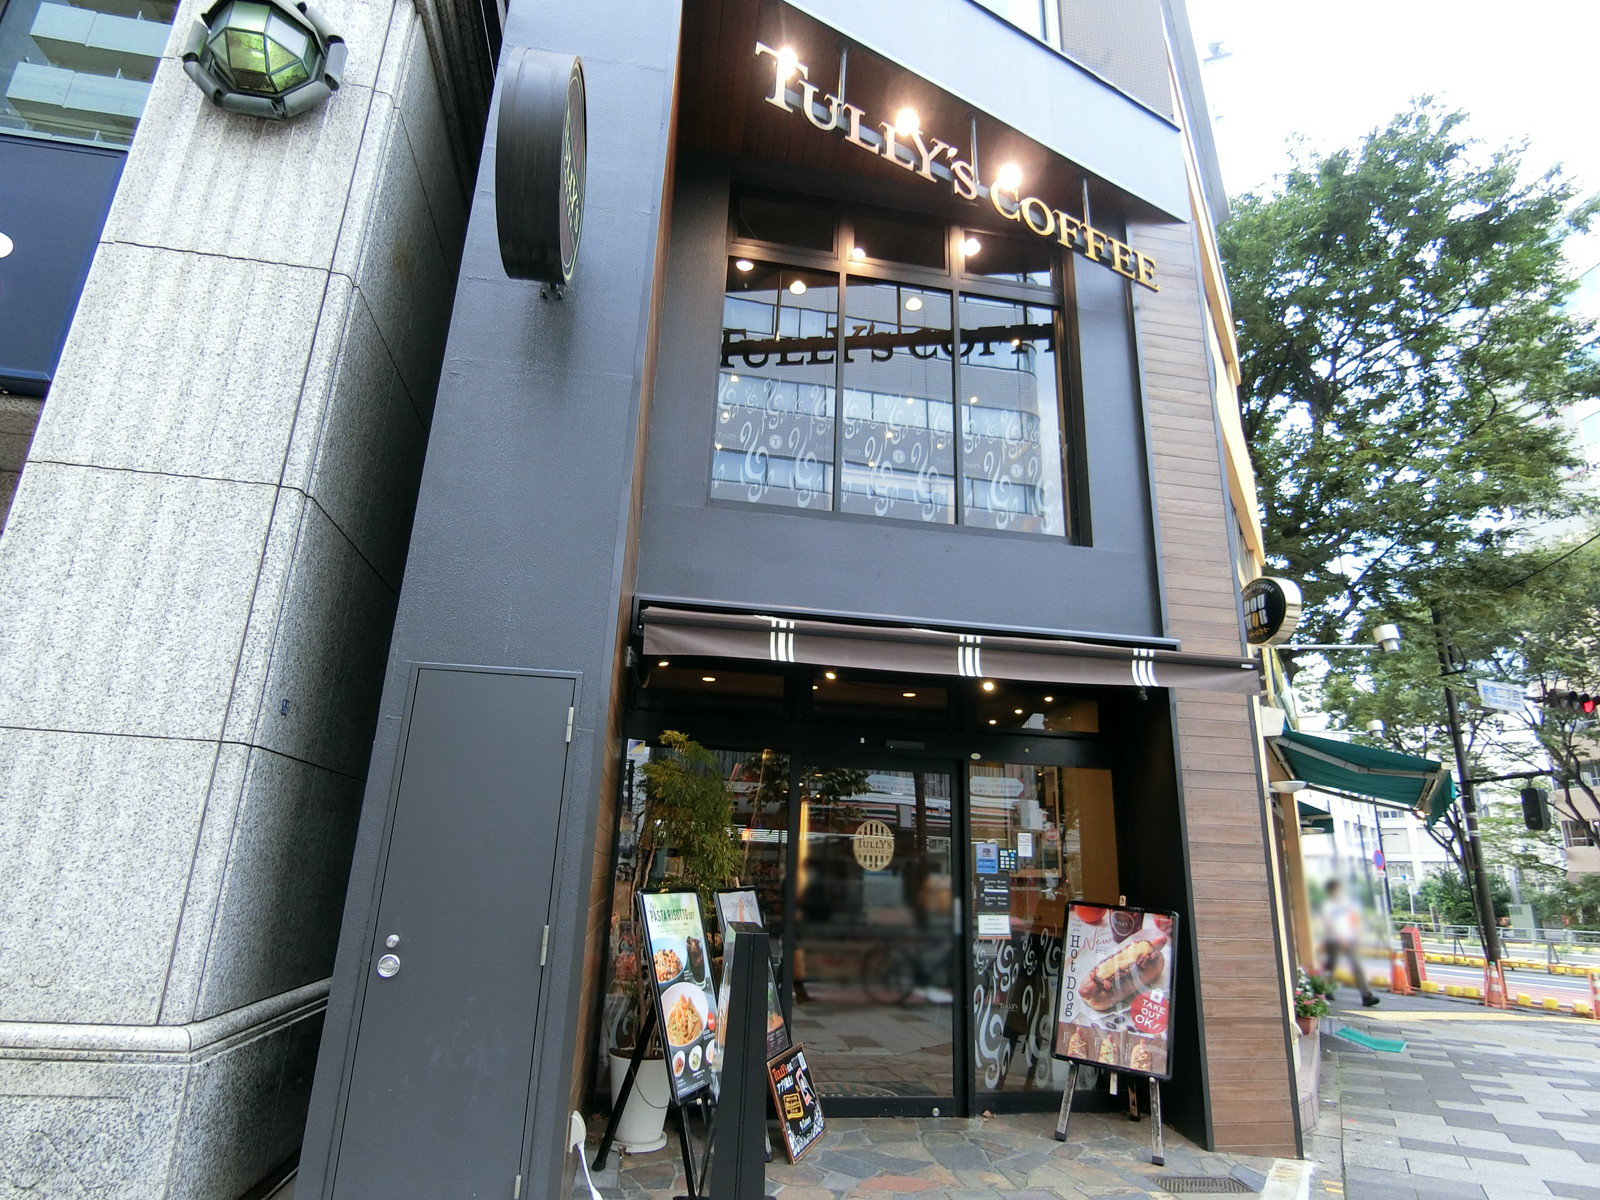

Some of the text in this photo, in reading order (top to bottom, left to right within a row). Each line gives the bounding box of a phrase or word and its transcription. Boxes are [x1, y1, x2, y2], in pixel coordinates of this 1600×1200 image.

[989, 180, 1161, 293] COFFEE
[856, 838, 892, 849] TULLY'S
[1082, 928, 1112, 950] New
[1141, 1007, 1161, 1020] OUT
[1142, 998, 1166, 1015] TAKE
